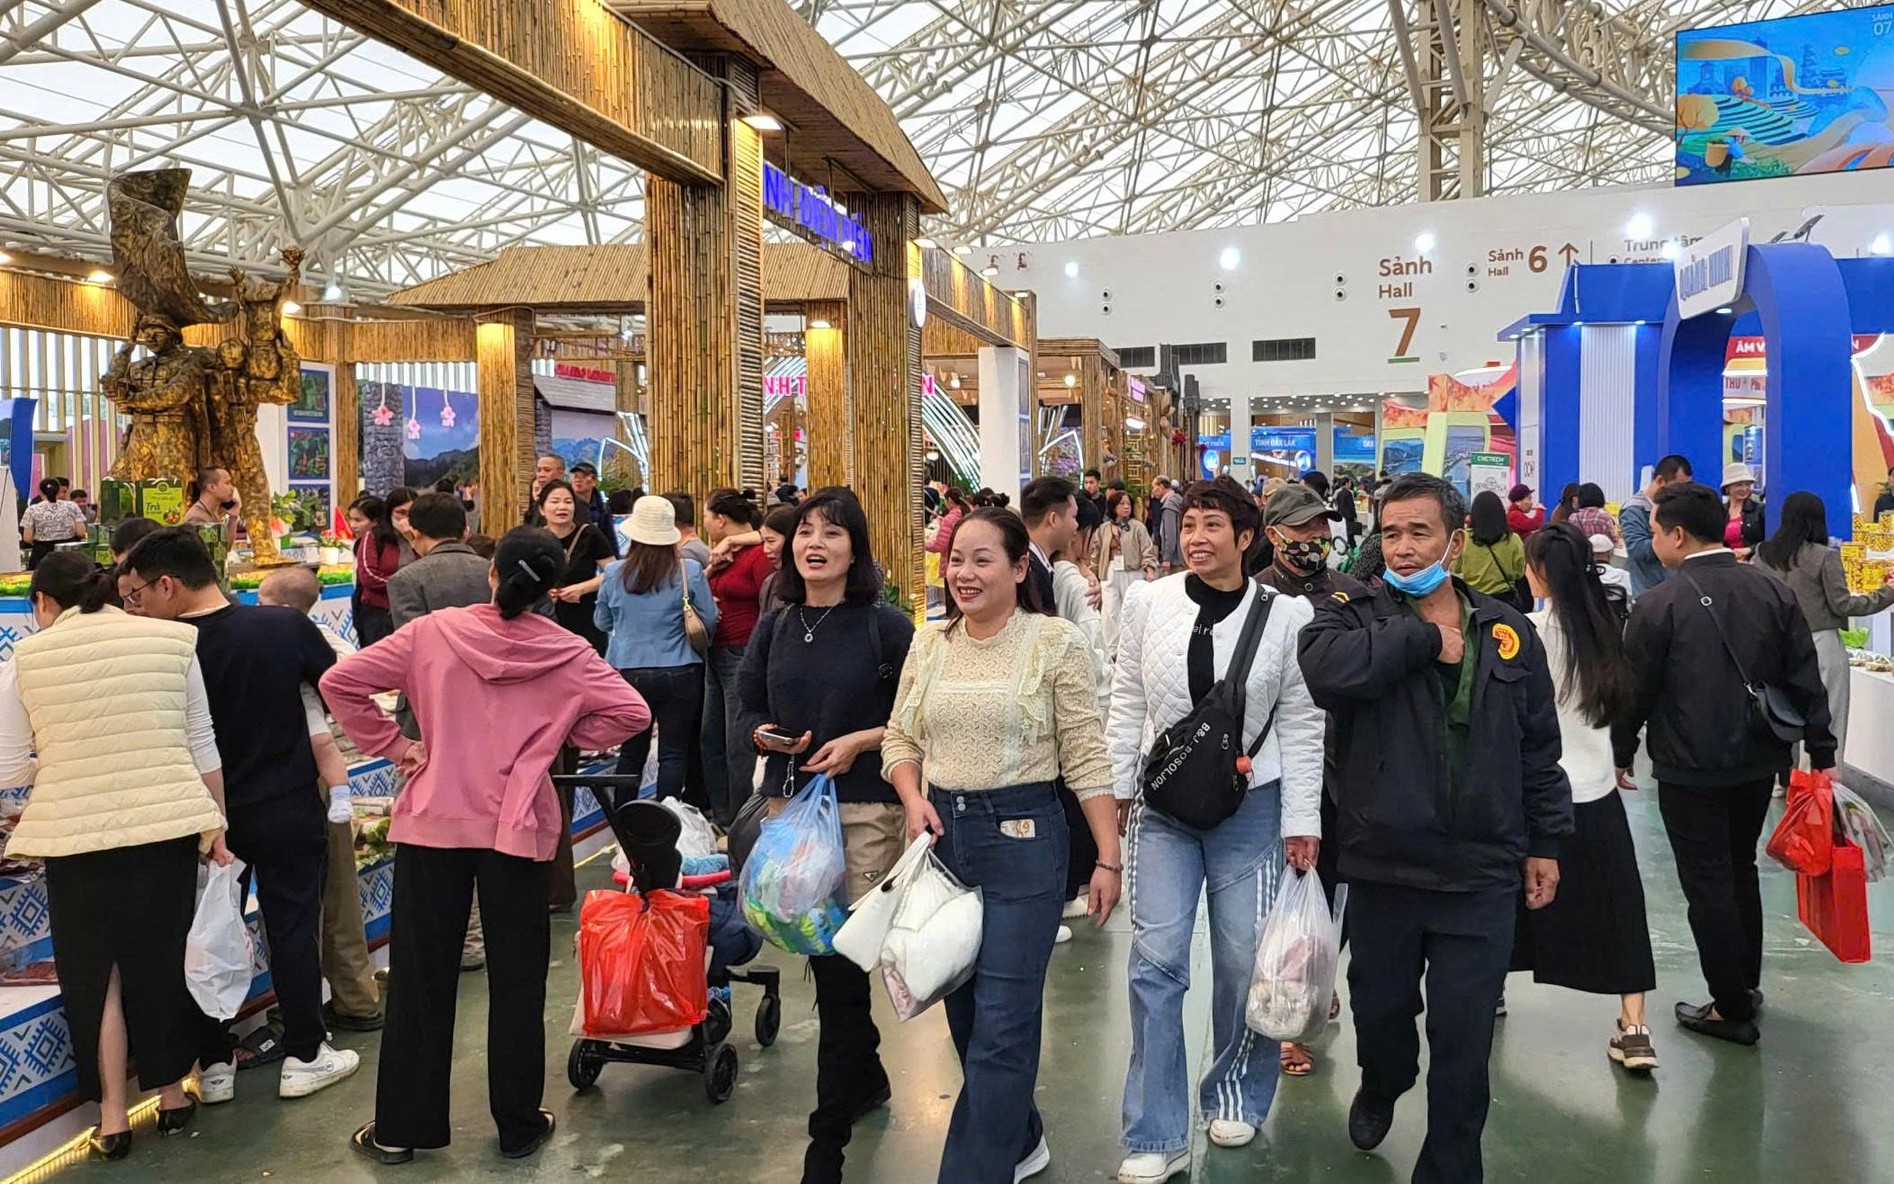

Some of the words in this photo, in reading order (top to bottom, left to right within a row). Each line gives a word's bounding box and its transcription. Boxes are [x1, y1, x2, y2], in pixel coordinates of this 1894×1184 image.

[1873, 21, 1893, 35] 07
[764, 164, 795, 220] NH
[1623, 239, 1668, 253] Trun
[1378, 256, 1432, 277] Sảnh
[1488, 248, 1524, 263] Sảnh
[1528, 245, 1548, 273] 6
[1488, 267, 1509, 277] Hall
[1378, 282, 1413, 299] Hall
[1388, 307, 1421, 357] 7
[764, 375, 792, 397] NH
[145, 501, 160, 511] Trà
